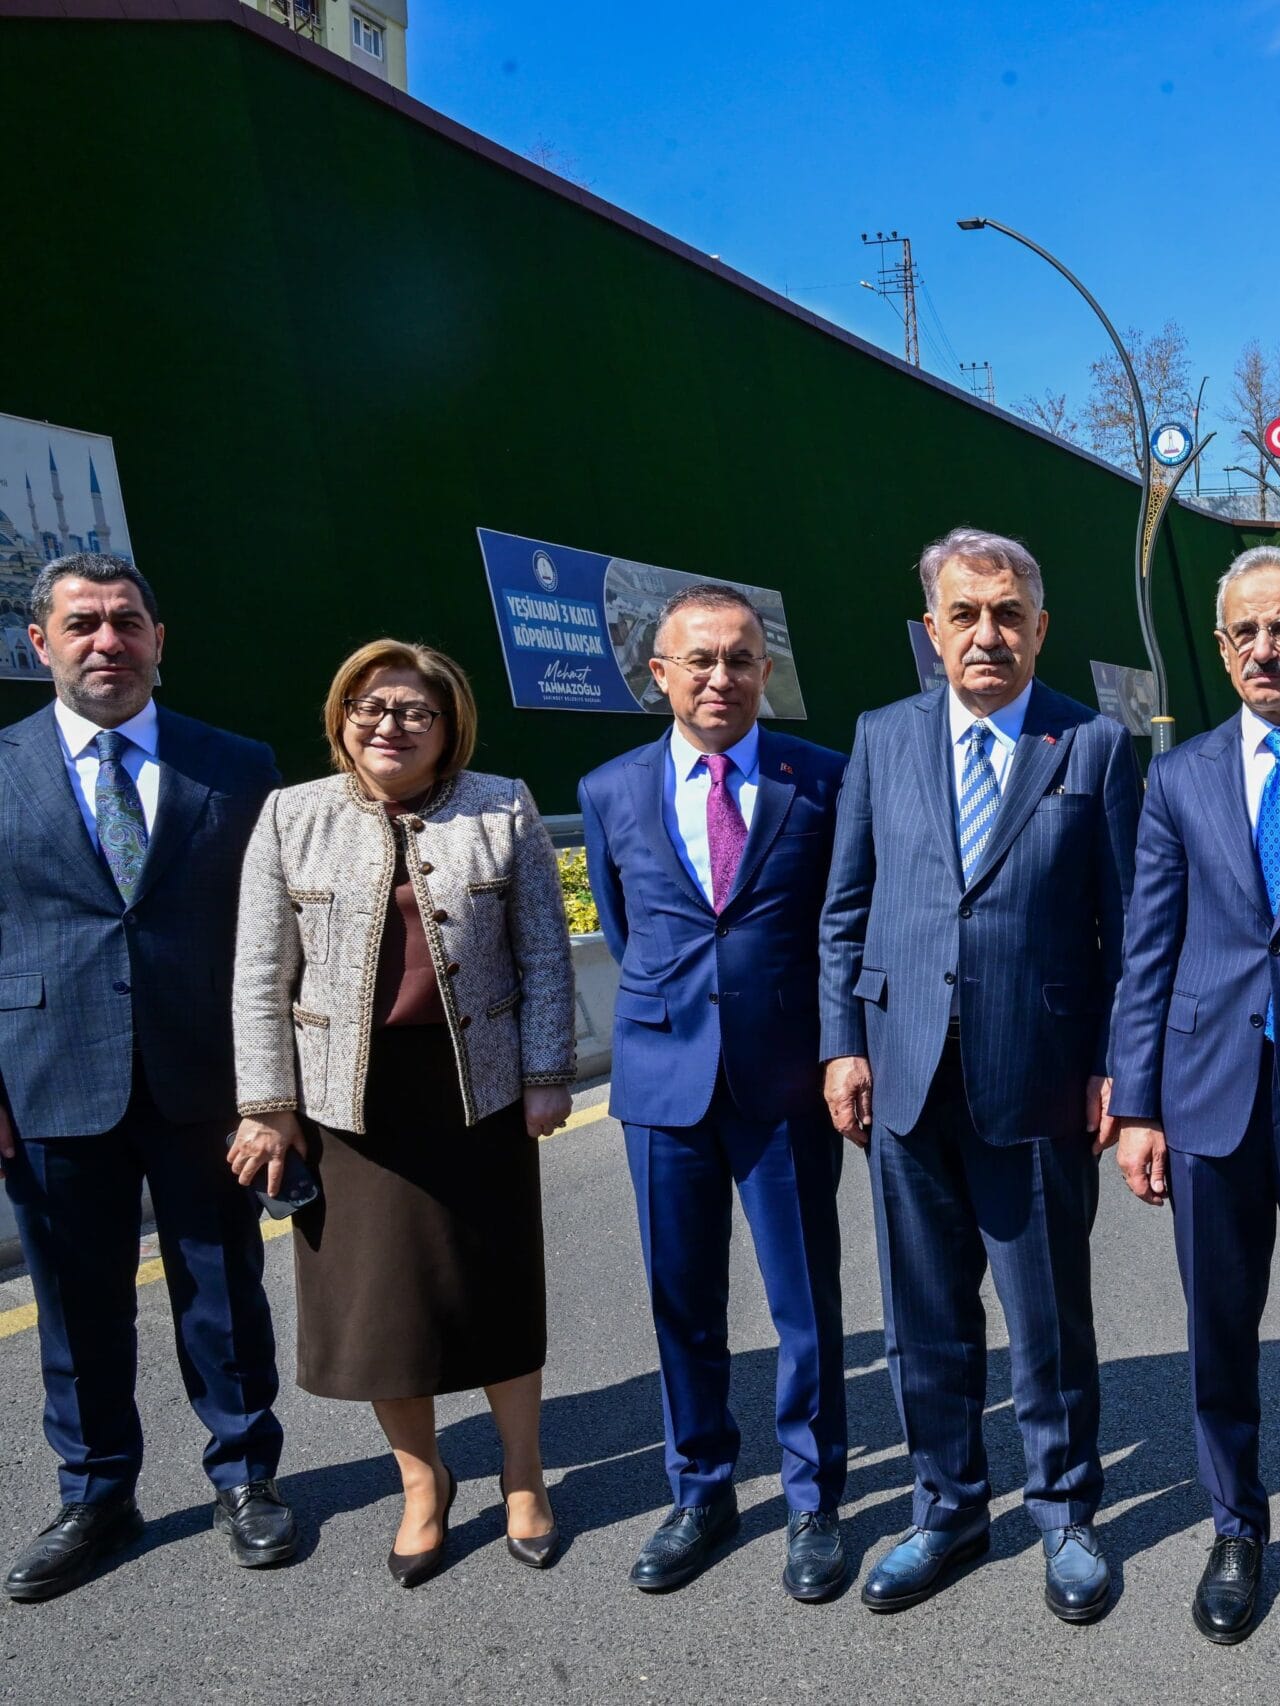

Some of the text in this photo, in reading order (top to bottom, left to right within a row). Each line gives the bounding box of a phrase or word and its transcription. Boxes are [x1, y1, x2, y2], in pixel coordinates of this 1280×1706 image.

[507, 595, 598, 627] YEŞİLVADİ 3 KATLI
[513, 623, 604, 656] KÖPRÜLÜ KAVŞAK
[544, 660, 592, 683] Mehmet
[538, 681, 601, 696] TAHMAZOĞLU
